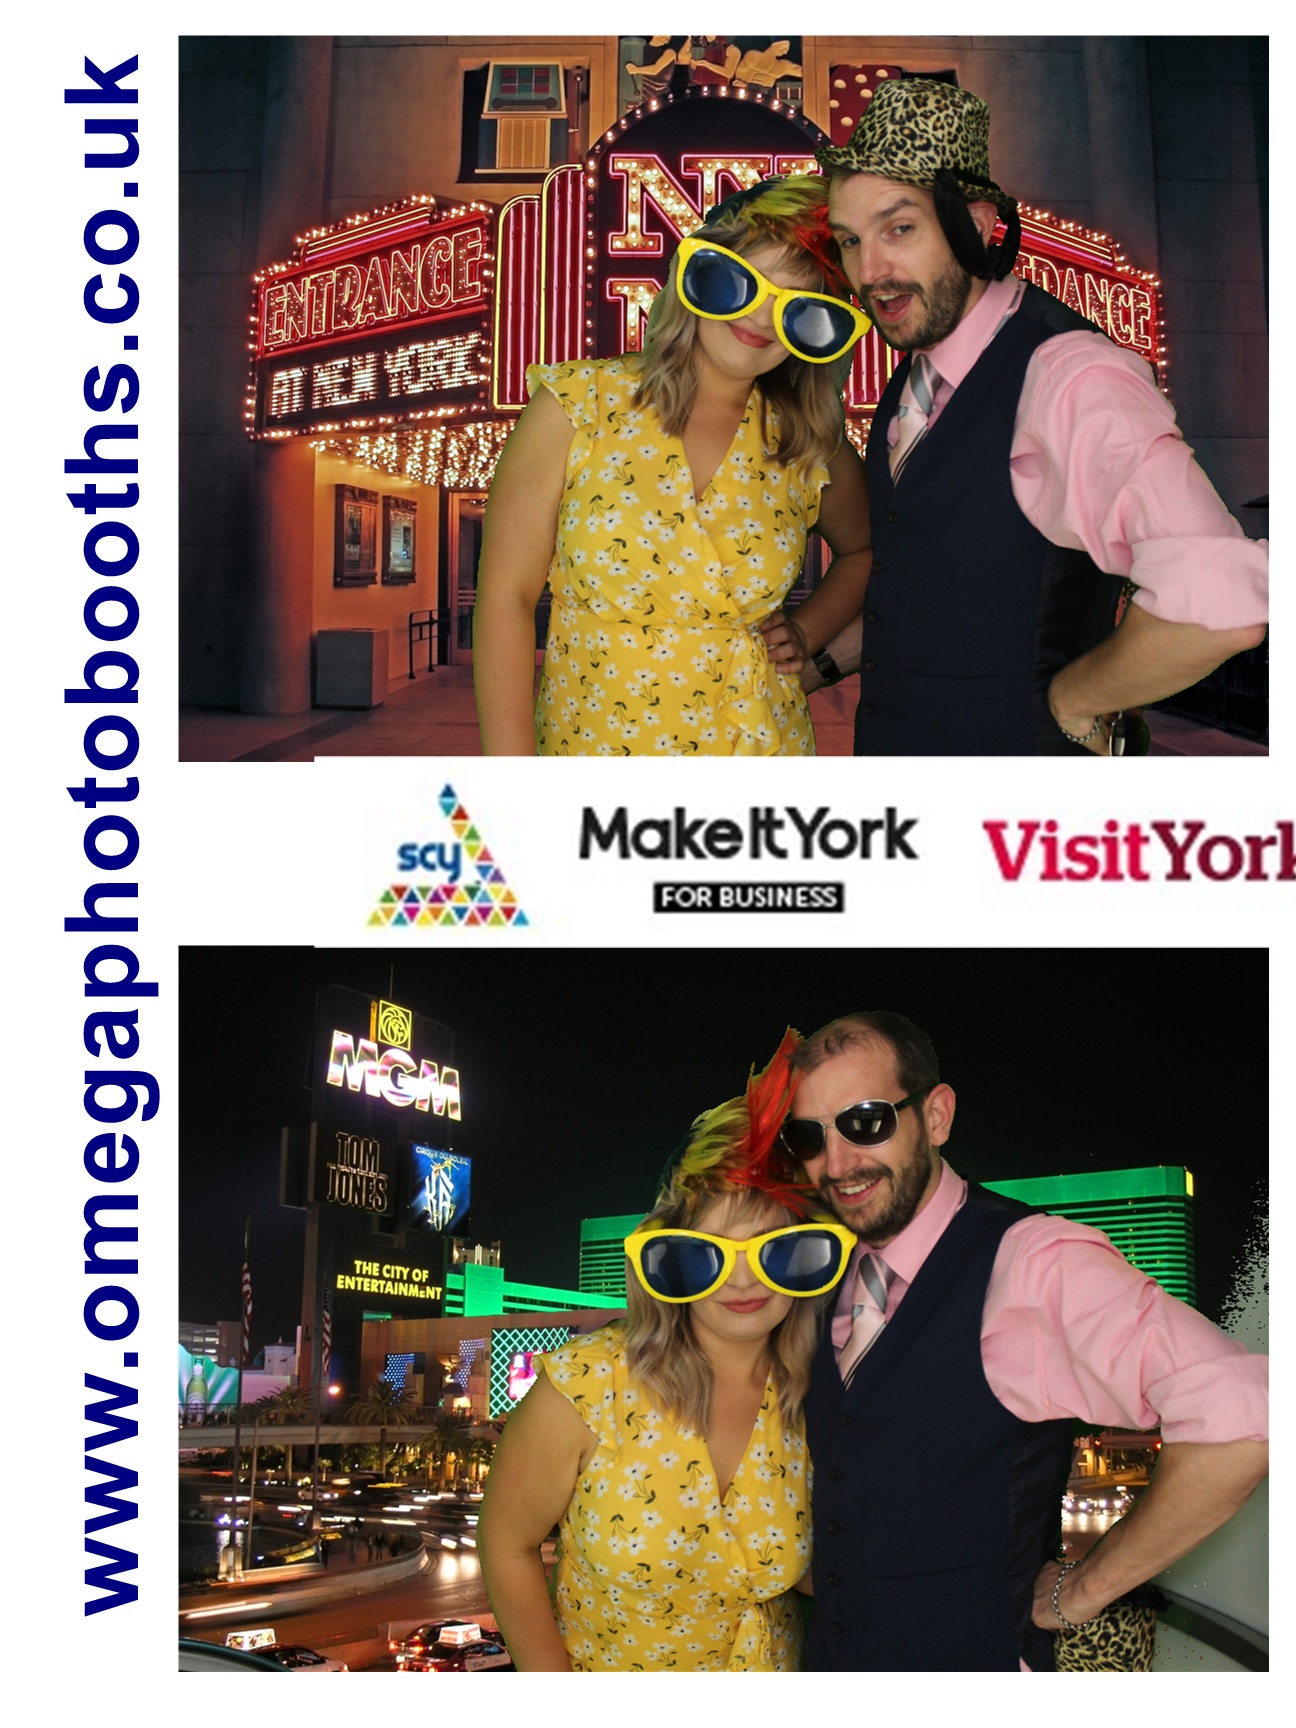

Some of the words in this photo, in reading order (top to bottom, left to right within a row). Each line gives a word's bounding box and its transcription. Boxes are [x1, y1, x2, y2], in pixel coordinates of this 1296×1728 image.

[263, 226, 483, 347] ENTRANCE
[312, 352, 379, 410] NEW
[384, 331, 482, 398] YORK
[327, 1029, 462, 1121] MGM
[336, 1131, 380, 1172] TOM
[327, 1167, 388, 1213] JONES
[336, 1274, 442, 1300] ENTERTAINMENT
[354, 1260, 380, 1276] THE
[382, 1264, 410, 1280] CITY
[412, 1268, 429, 1283] OF
